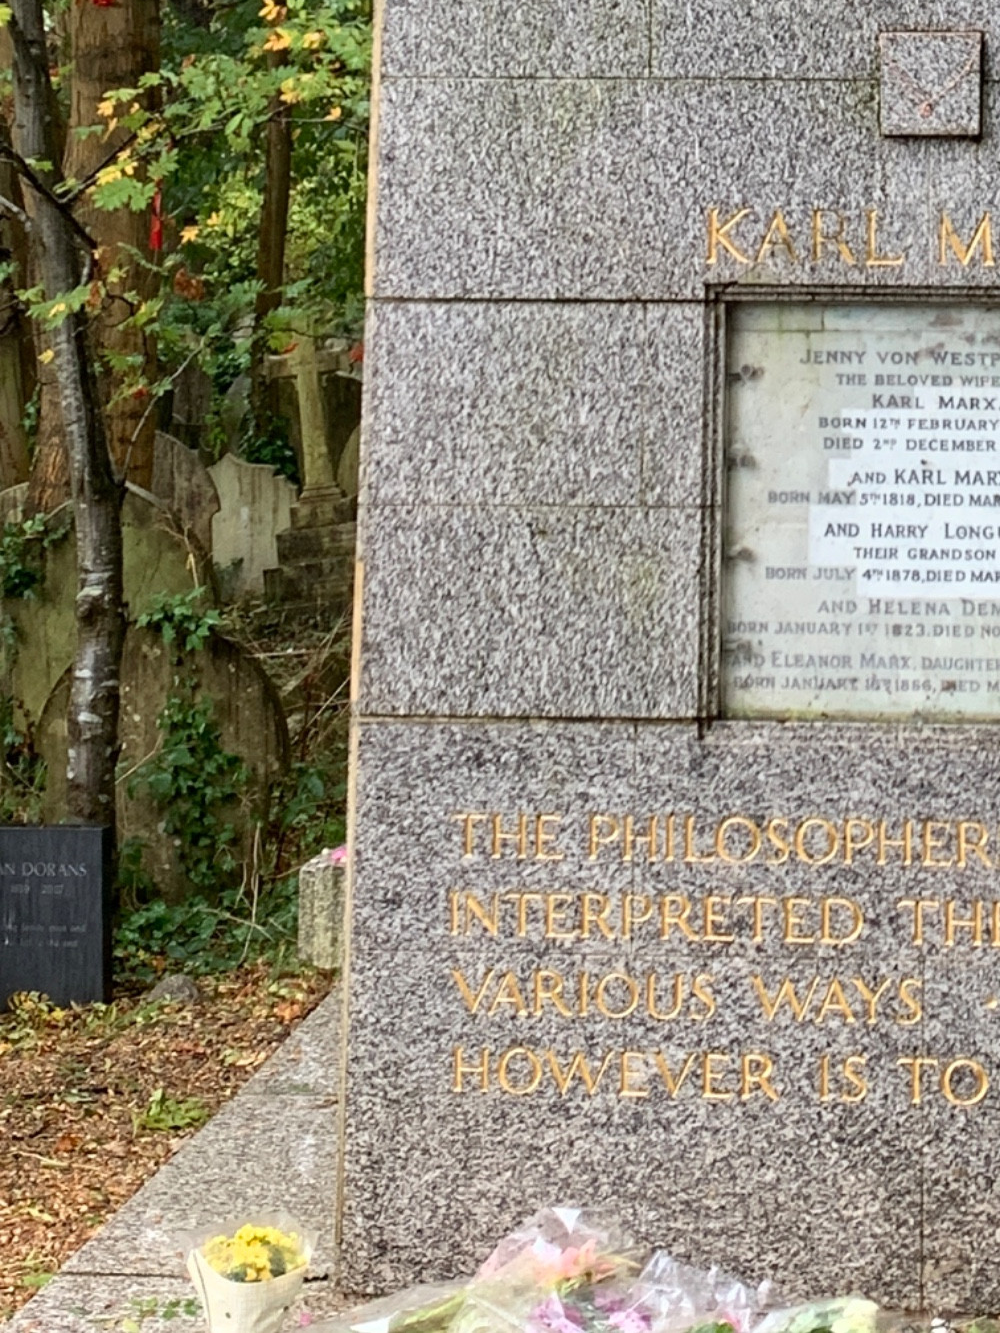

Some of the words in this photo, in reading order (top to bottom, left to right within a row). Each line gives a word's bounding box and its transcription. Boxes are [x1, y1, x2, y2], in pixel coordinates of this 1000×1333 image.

[704, 207, 904, 268] KARL
[800, 350, 866, 365] JENNY
[877, 351, 918, 365] VON
[836, 374, 867, 386] THE
[874, 374, 953, 386] BELOVED
[960, 375, 1000, 387] WIFE
[872, 394, 925, 409] KARL
[818, 417, 867, 429] BORN
[907, 419, 1000, 431] FEBRUARY
[823, 437, 864, 450] DIED
[906, 439, 997, 452] DECEMBER
[849, 471, 886, 485] AND
[894, 469, 947, 485] KARL
[768, 490, 811, 504] BORN
[818, 491, 856, 505] MAY
[924, 493, 964, 507] DIED
[824, 523, 860, 538] AND
[871, 523, 929, 538] HARRY
[853, 547, 898, 560] THEIR
[907, 548, 996, 560] GRANDSON
[765, 567, 807, 580] BORN
[813, 567, 856, 581] JULY
[926, 570, 966, 582] DIED
[818, 600, 857, 614] AND
[868, 599, 950, 615] HELENA
[728, 621, 768, 634] BORN
[774, 621, 852, 635] JANUARY
[933, 624, 975, 637] DIED
[771, 650, 851, 667] ELEANOR
[733, 676, 775, 689] BORN
[781, 677, 858, 691] JANUARY
[940, 680, 980, 693] DIED
[455, 812, 562, 860] THE
[21, 861, 87, 877] DORANS
[448, 890, 866, 947] INTERPRETED
[450, 968, 718, 1021] VARIOUS
[750, 973, 924, 1026] WAYS
[451, 1045, 781, 1103] HOWEVER
[817, 1052, 870, 1104] IS
[894, 1055, 991, 1108] TO
